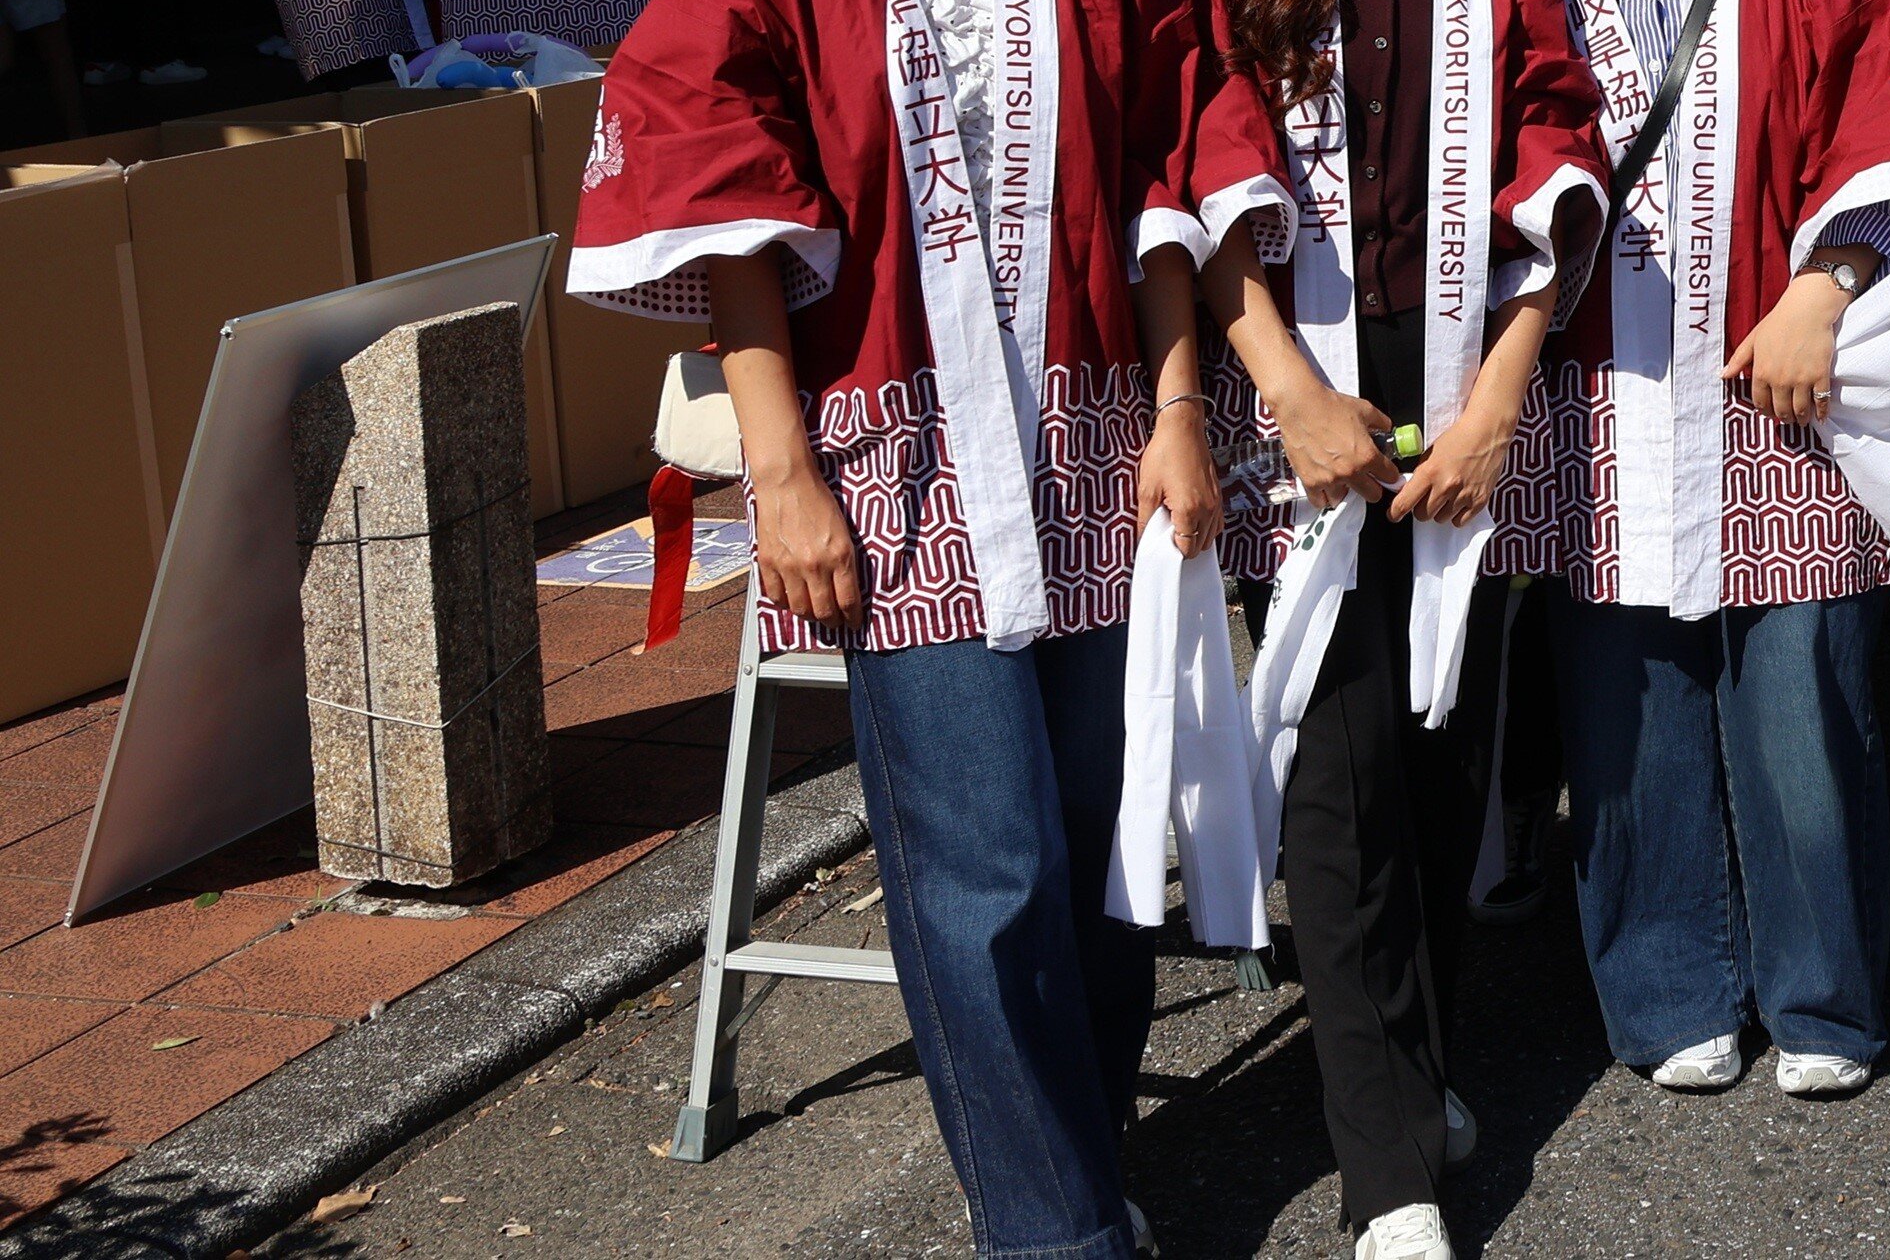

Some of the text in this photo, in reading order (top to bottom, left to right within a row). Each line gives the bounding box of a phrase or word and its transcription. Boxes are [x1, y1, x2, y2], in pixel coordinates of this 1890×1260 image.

[994, 143, 1030, 334] UNIVERSITY
[1438, 146, 1467, 322] UNIVERSITY
[1689, 162, 1715, 335] UNIVERSITY
